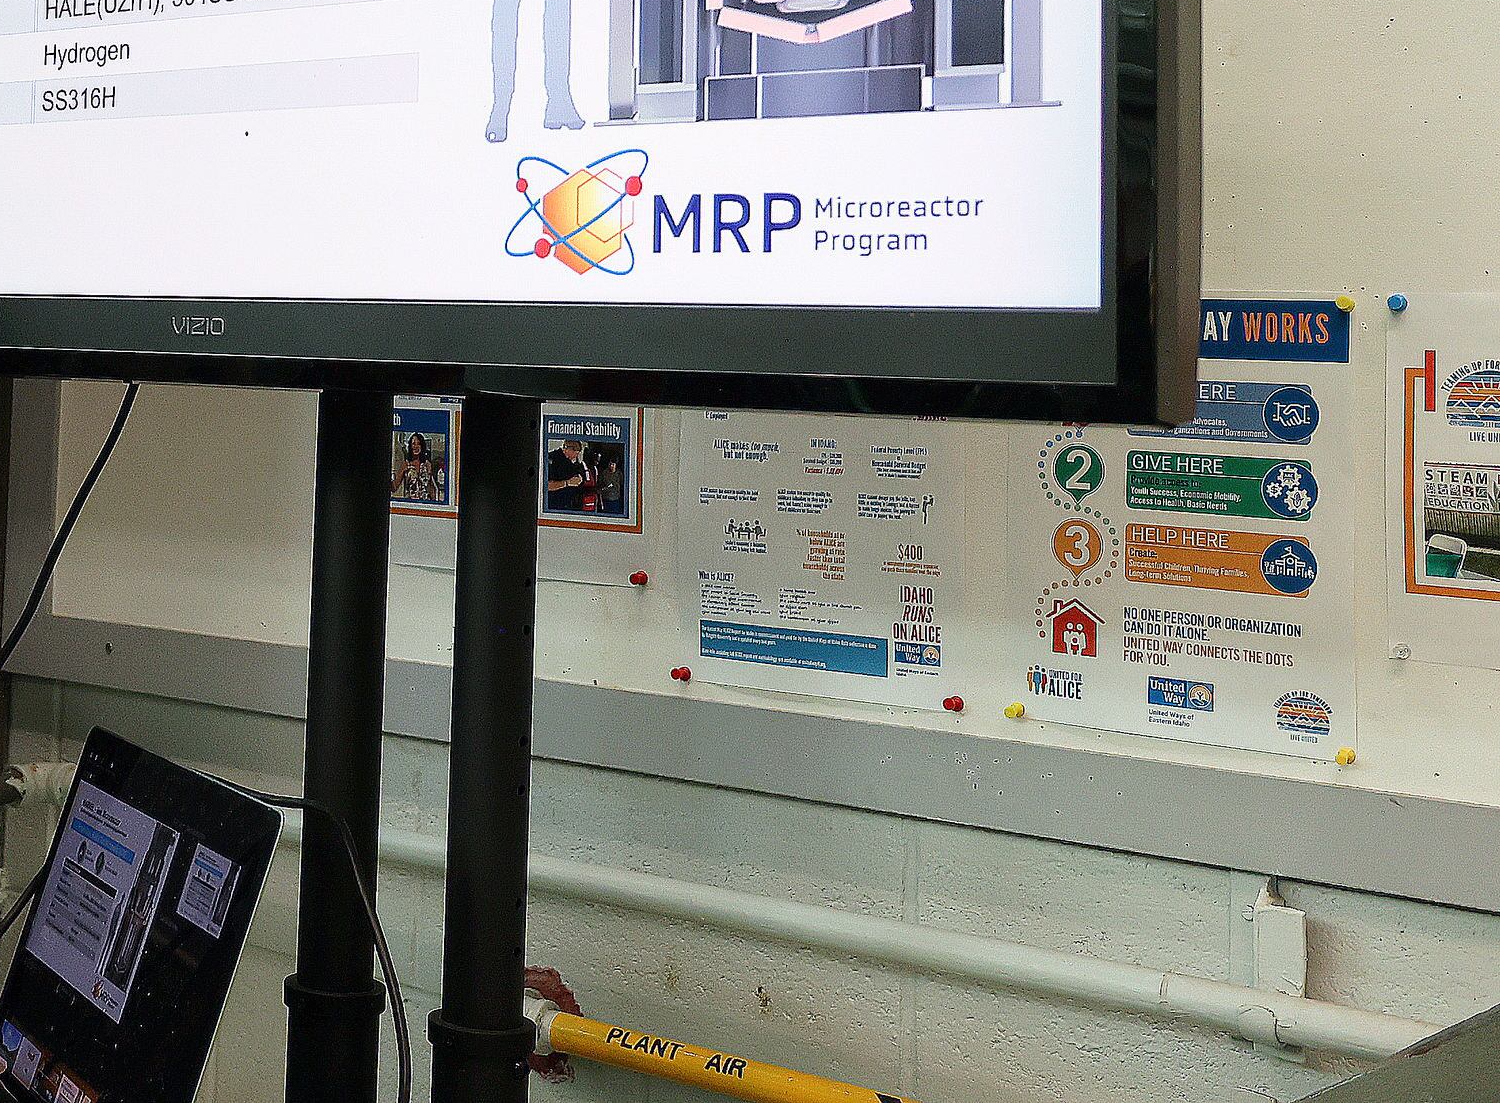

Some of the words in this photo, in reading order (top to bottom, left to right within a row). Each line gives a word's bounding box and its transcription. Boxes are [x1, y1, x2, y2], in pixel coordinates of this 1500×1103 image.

[43, 43, 130, 70] Hydrogen
[42, 86, 116, 112] SS316H
[815, 196, 983, 218] Microreactor
[653, 193, 801, 253] MRP
[815, 230, 928, 256] Program
[171, 316, 225, 336] VIZIO
[1203, 311, 1232, 342] AY
[1242, 311, 1330, 344] WORKS
[1441, 364, 1470, 392] TEAMING
[1471, 361, 1482, 371] UP
[1199, 384, 1237, 400] ERE
[547, 420, 584, 435] Financial
[586, 422, 622, 439] Stability
[1225, 429, 1268, 438] Governments
[1469, 432, 1486, 442] LIVE
[714, 439, 729, 449] ALICE
[1066, 450, 1092, 490] 2
[1132, 454, 1171, 471] GIVE
[1177, 457, 1223, 474] HERE
[1425, 469, 1488, 485] STEAM
[1131, 486, 1148, 495] Youth
[1150, 488, 1179, 497] Success,
[1180, 490, 1212, 499] Economic
[1130, 496, 1153, 504] Access
[1187, 500, 1205, 508] Basic
[1207, 502, 1227, 510] Needs
[1428, 498, 1490, 511] EDUCATION
[1064, 526, 1091, 566] 3
[1132, 526, 1177, 543] HELP
[1183, 530, 1230, 548] HERE
[898, 544, 923, 561] $400
[1129, 547, 1157, 557] Create:
[1129, 559, 1163, 569] Successful
[900, 585, 933, 604] IDAHO
[903, 605, 933, 623] RUNS
[1124, 607, 1137, 620] NO
[1141, 609, 1161, 623] ONE
[1164, 611, 1204, 627] PERSON
[1208, 615, 1222, 629] OR
[1225, 617, 1301, 637] ORGANIZATION
[893, 623, 907, 639] ON
[910, 624, 941, 643] ALICE
[1124, 620, 1143, 634] CAN
[1147, 622, 1160, 635] DO
[1164, 625, 1173, 637] IT
[1175, 626, 1210, 641] ALONE.
[896, 643, 920, 653] United
[1124, 636, 1159, 651] UNITED
[1162, 640, 1183, 654] WAY
[1186, 643, 1240, 661] CONNECTS
[1243, 649, 1262, 663] THE
[1266, 652, 1293, 667] DOTS
[905, 652, 920, 663] Way
[1124, 649, 1143, 663] FOR
[1146, 652, 1170, 667] YOU.
[1049, 669, 1069, 680] UNITED
[1071, 672, 1083, 681] FOR
[1048, 679, 1082, 699] ALICE
[1150, 678, 1185, 693] United
[1163, 691, 1185, 706] Way
[1149, 709, 1168, 717] United
[1170, 711, 1186, 720] Ways
[1149, 717, 1172, 725] Eastern
[606, 1027, 685, 1061] PLANT
[705, 1054, 748, 1079] AIR
